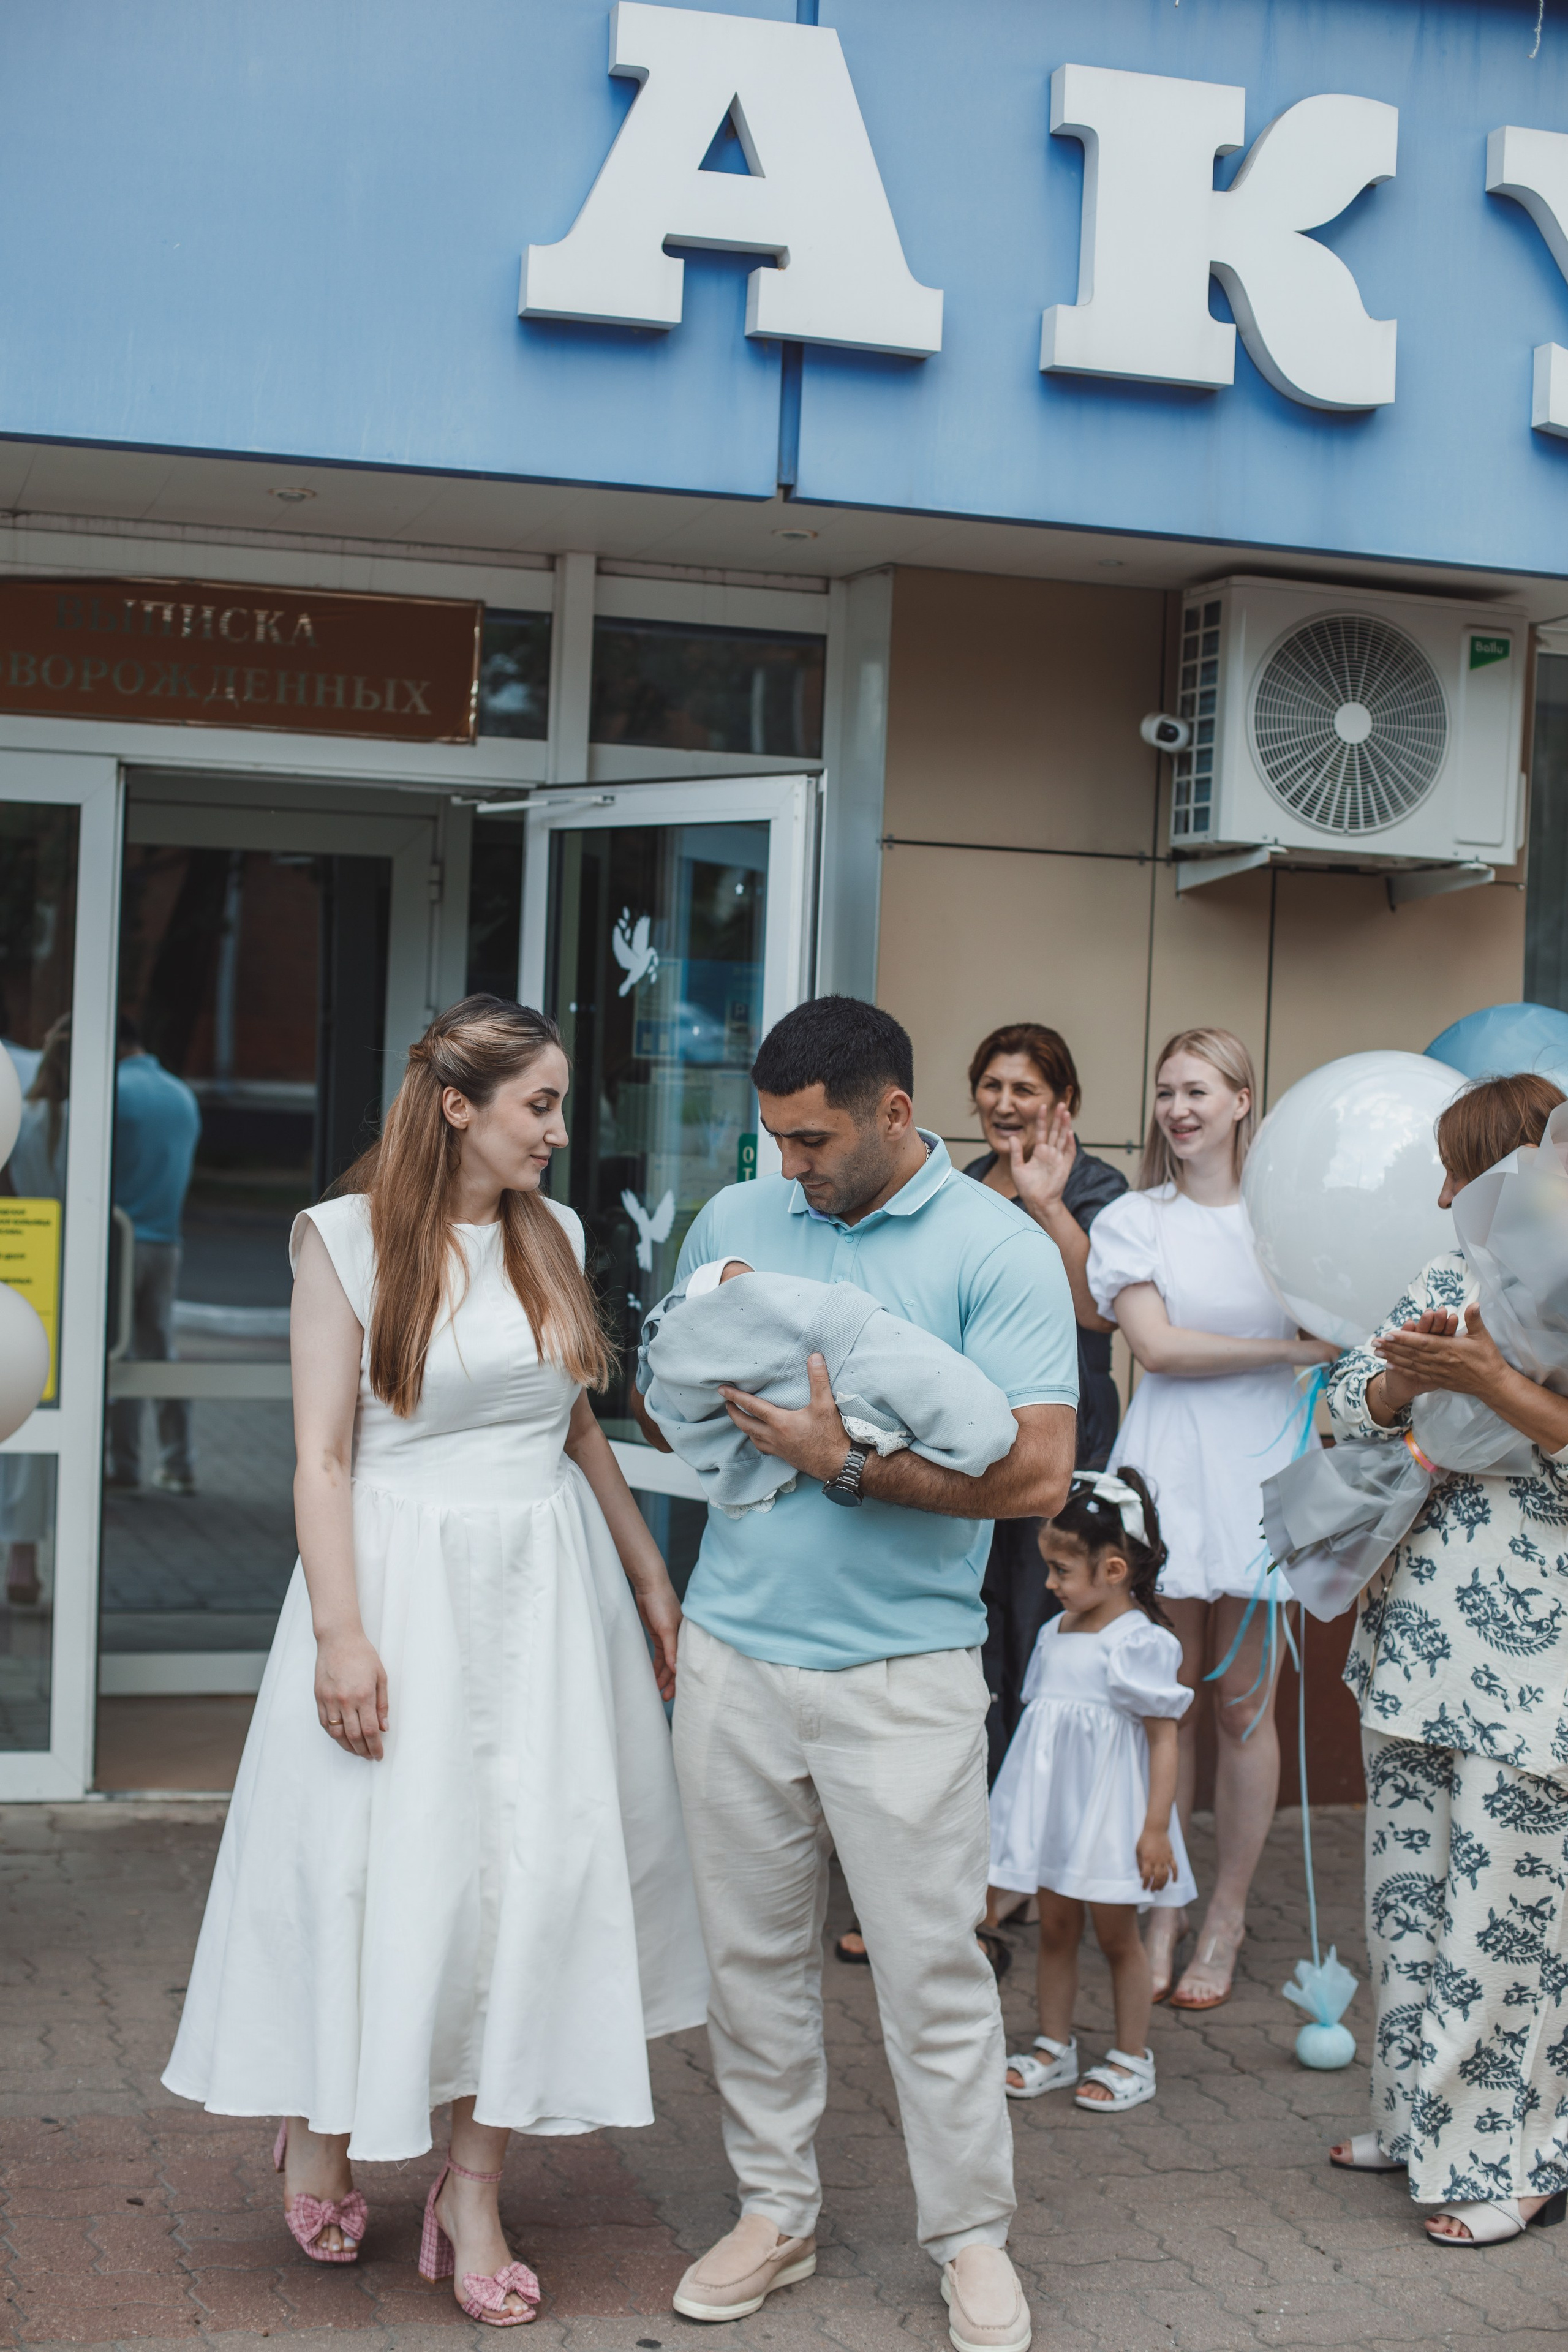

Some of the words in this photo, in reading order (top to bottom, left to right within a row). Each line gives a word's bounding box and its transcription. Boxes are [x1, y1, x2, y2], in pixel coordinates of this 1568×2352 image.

[519, 1, 1568, 437] АК
[55, 594, 319, 647] ВЫПИСКА
[1475, 640, 1504, 654] Ballu
[0, 650, 431, 715] ВОРОЖДЕННЫХ
